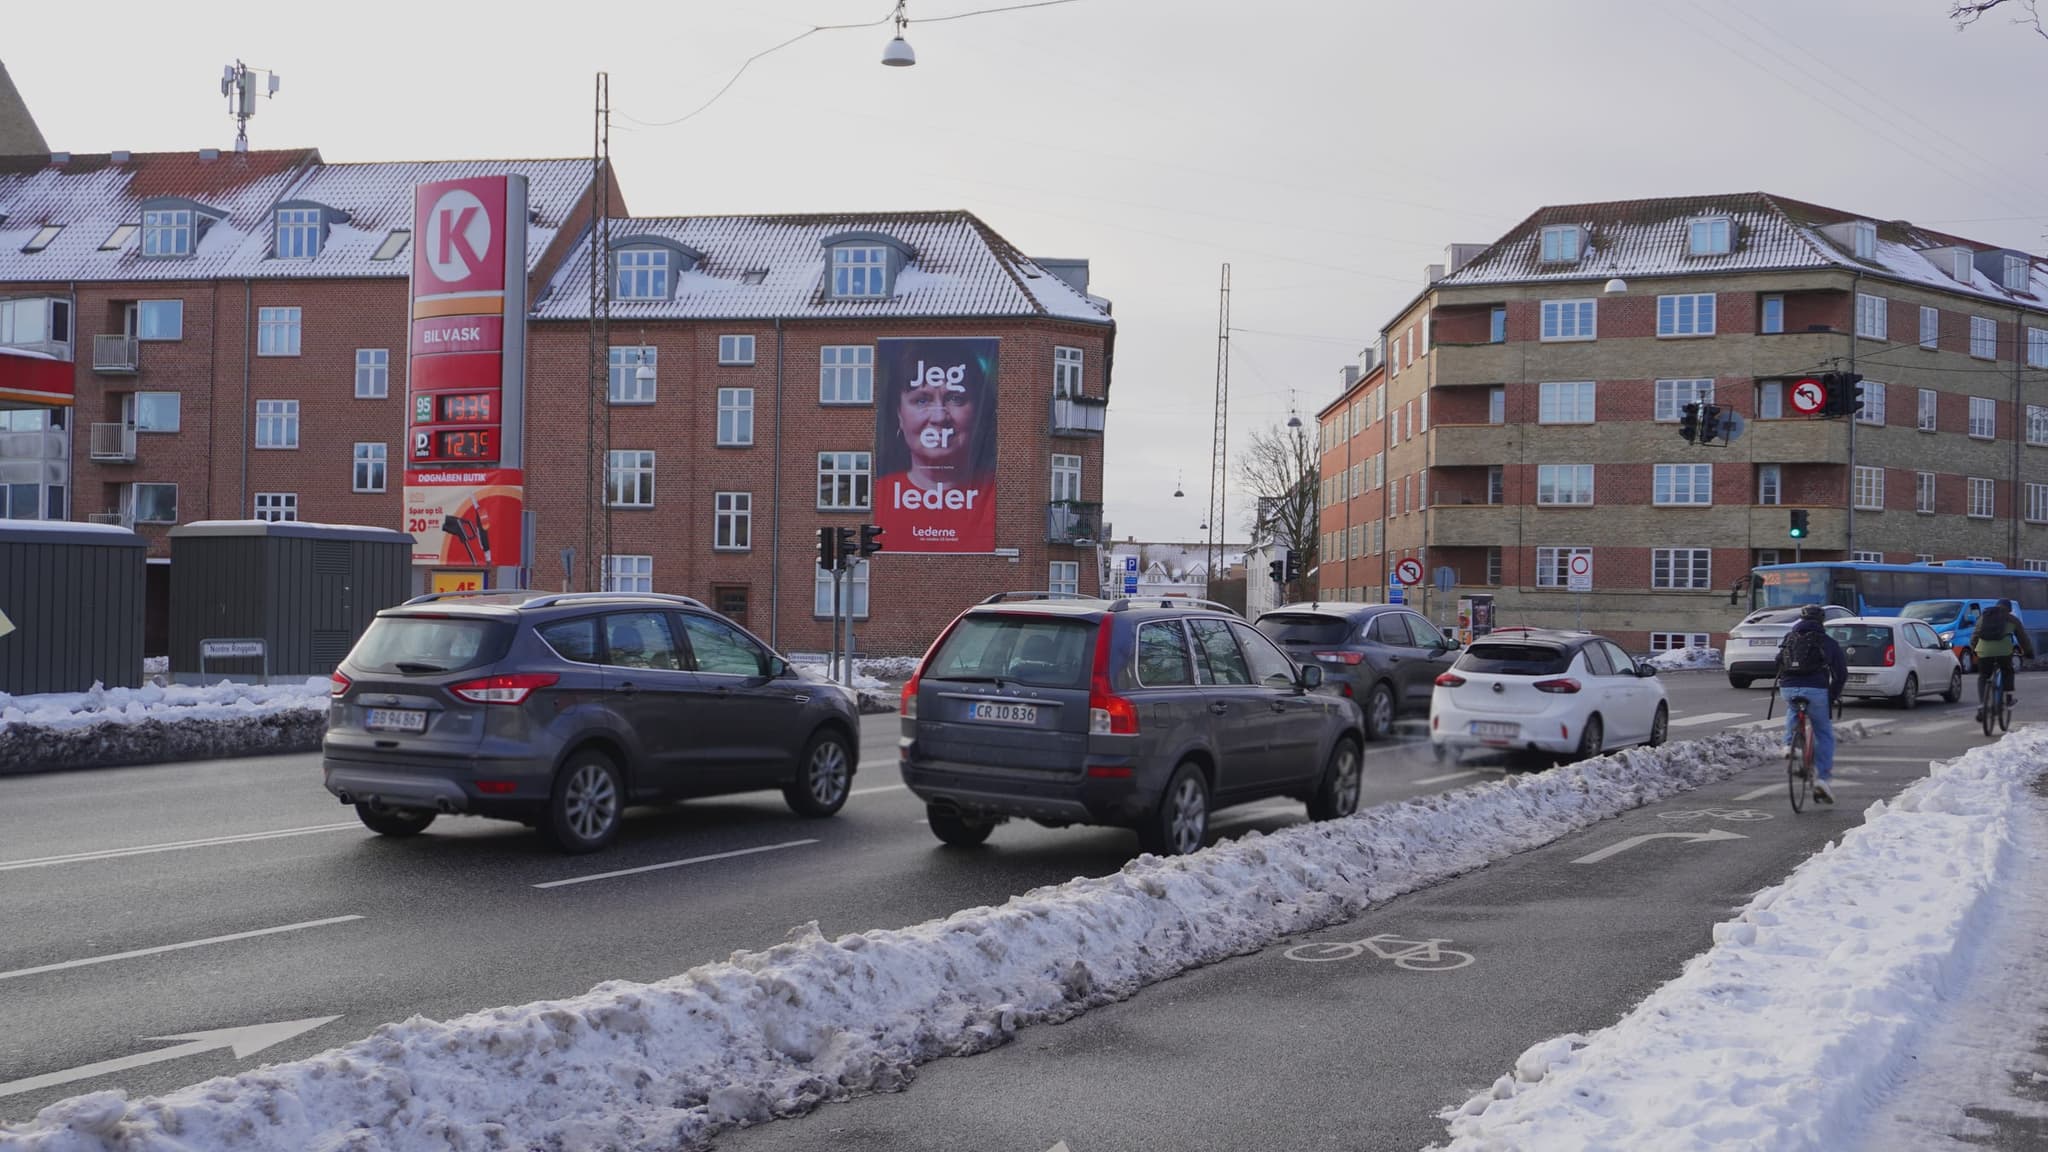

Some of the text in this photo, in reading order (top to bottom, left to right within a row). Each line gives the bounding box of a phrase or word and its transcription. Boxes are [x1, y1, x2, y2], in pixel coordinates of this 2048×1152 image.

[423, 327, 480, 344] BILVASK
[910, 360, 966, 392] Jeg
[416, 397, 431, 413] 95
[417, 433, 428, 449] D
[919, 426, 954, 448] er
[418, 472, 486, 482] DØGNÅBEN BUTIK
[894, 481, 978, 510] leder
[409, 507, 424, 515] Spar
[409, 519, 426, 533] 20
[912, 525, 956, 537] Lederne
[977, 704, 1035, 721] CR 10 836
